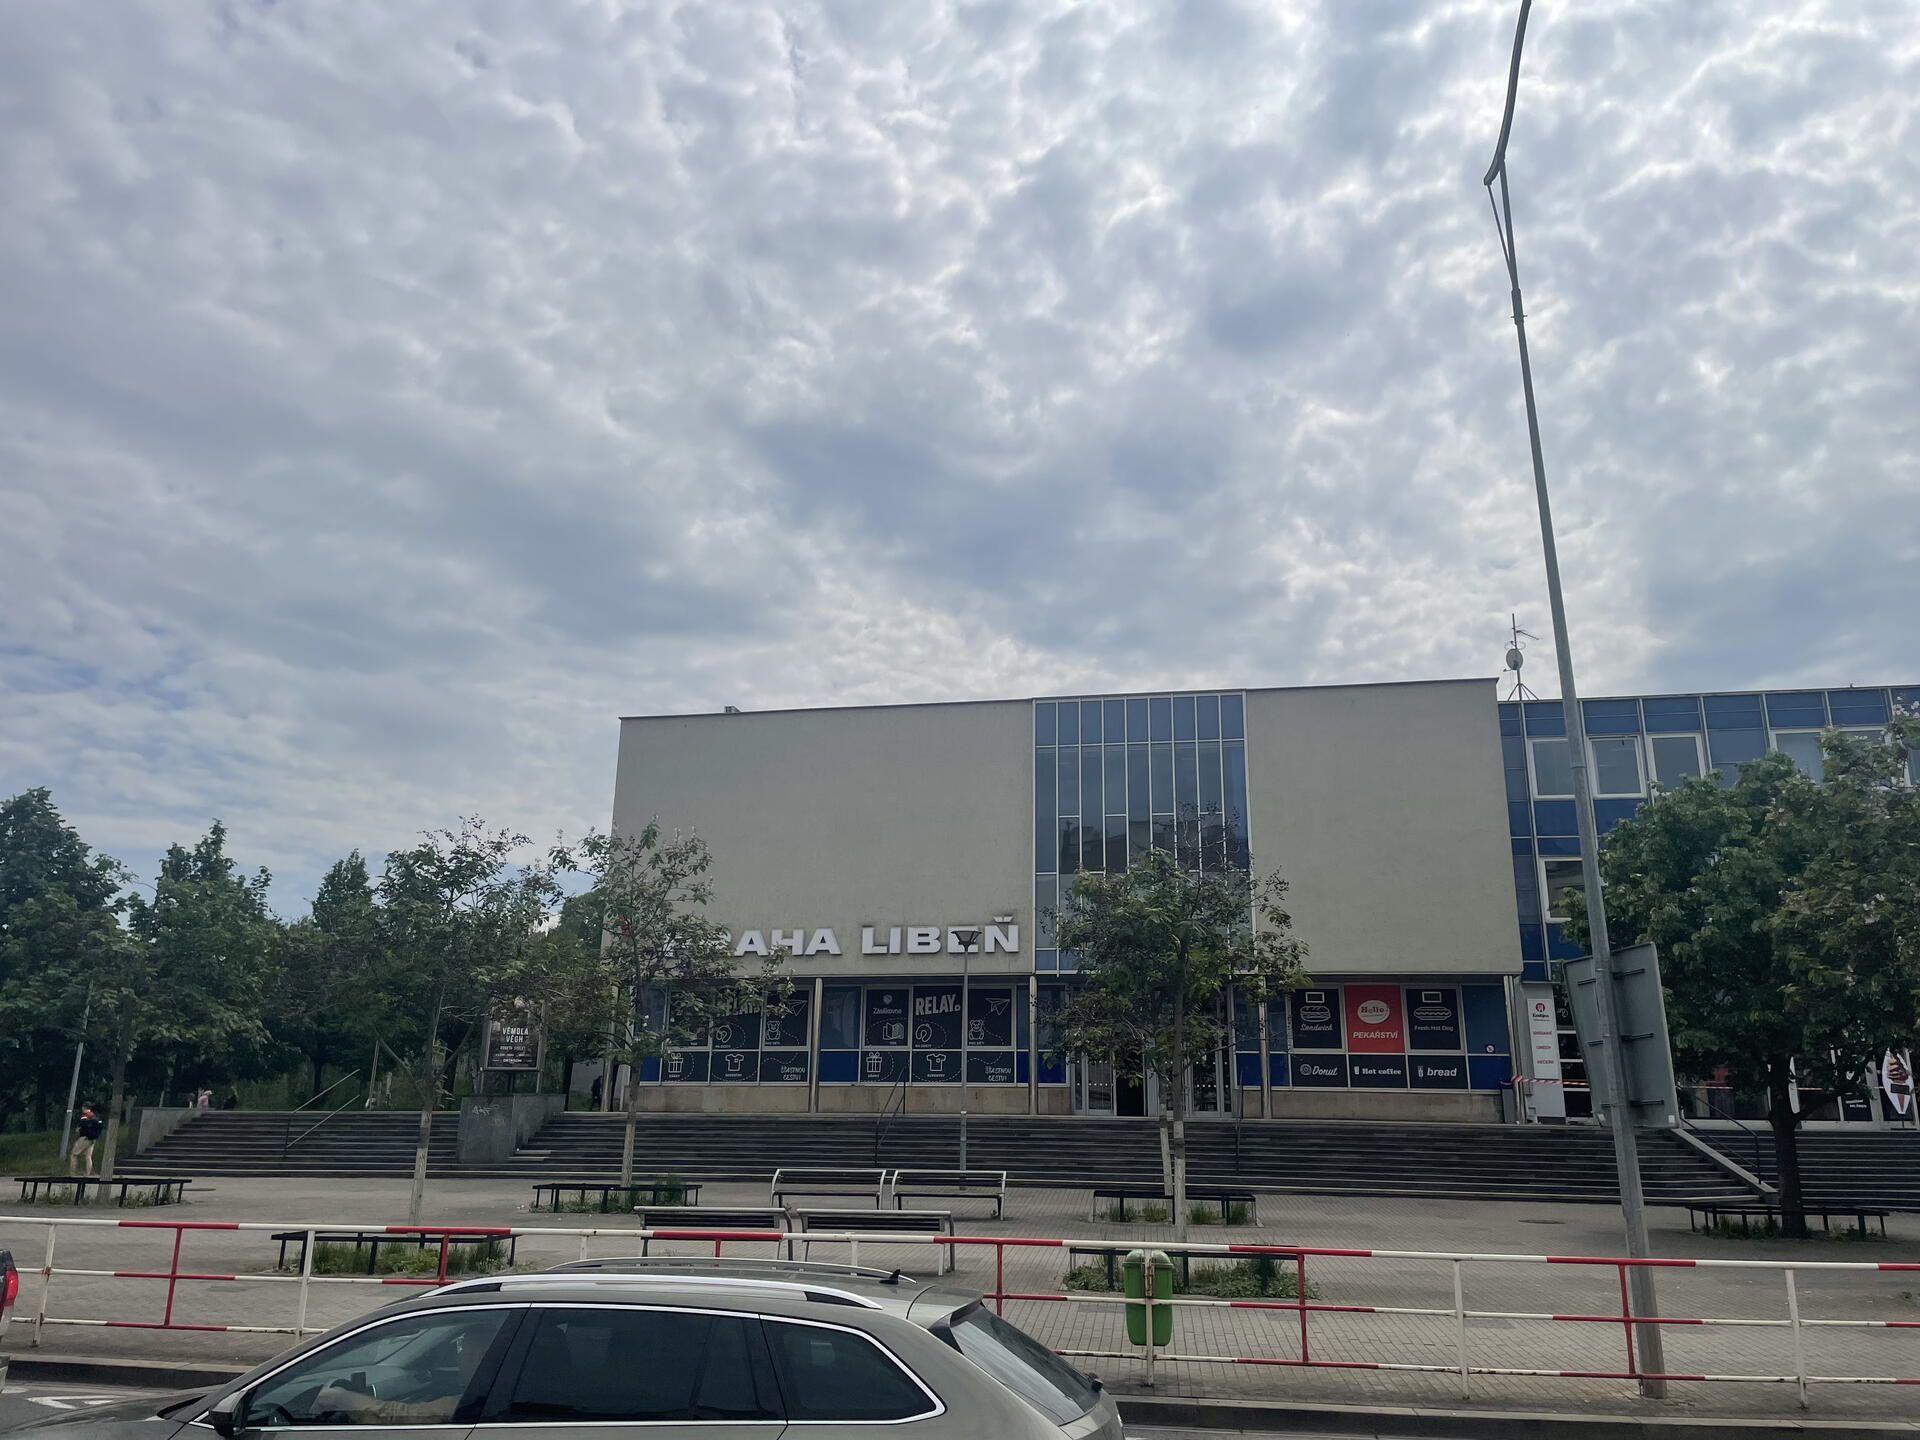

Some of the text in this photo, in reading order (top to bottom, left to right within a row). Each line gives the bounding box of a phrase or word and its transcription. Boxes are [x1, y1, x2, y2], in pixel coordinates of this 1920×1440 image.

[663, 915, 1019, 957] AHA LIBEŇ
[1300, 1022, 1334, 1031] Sandwich
[1353, 1030, 1398, 1039] PEKAŘSTVÍ
[1312, 1065, 1338, 1076] Donut
[1427, 1067, 1457, 1076] bread
